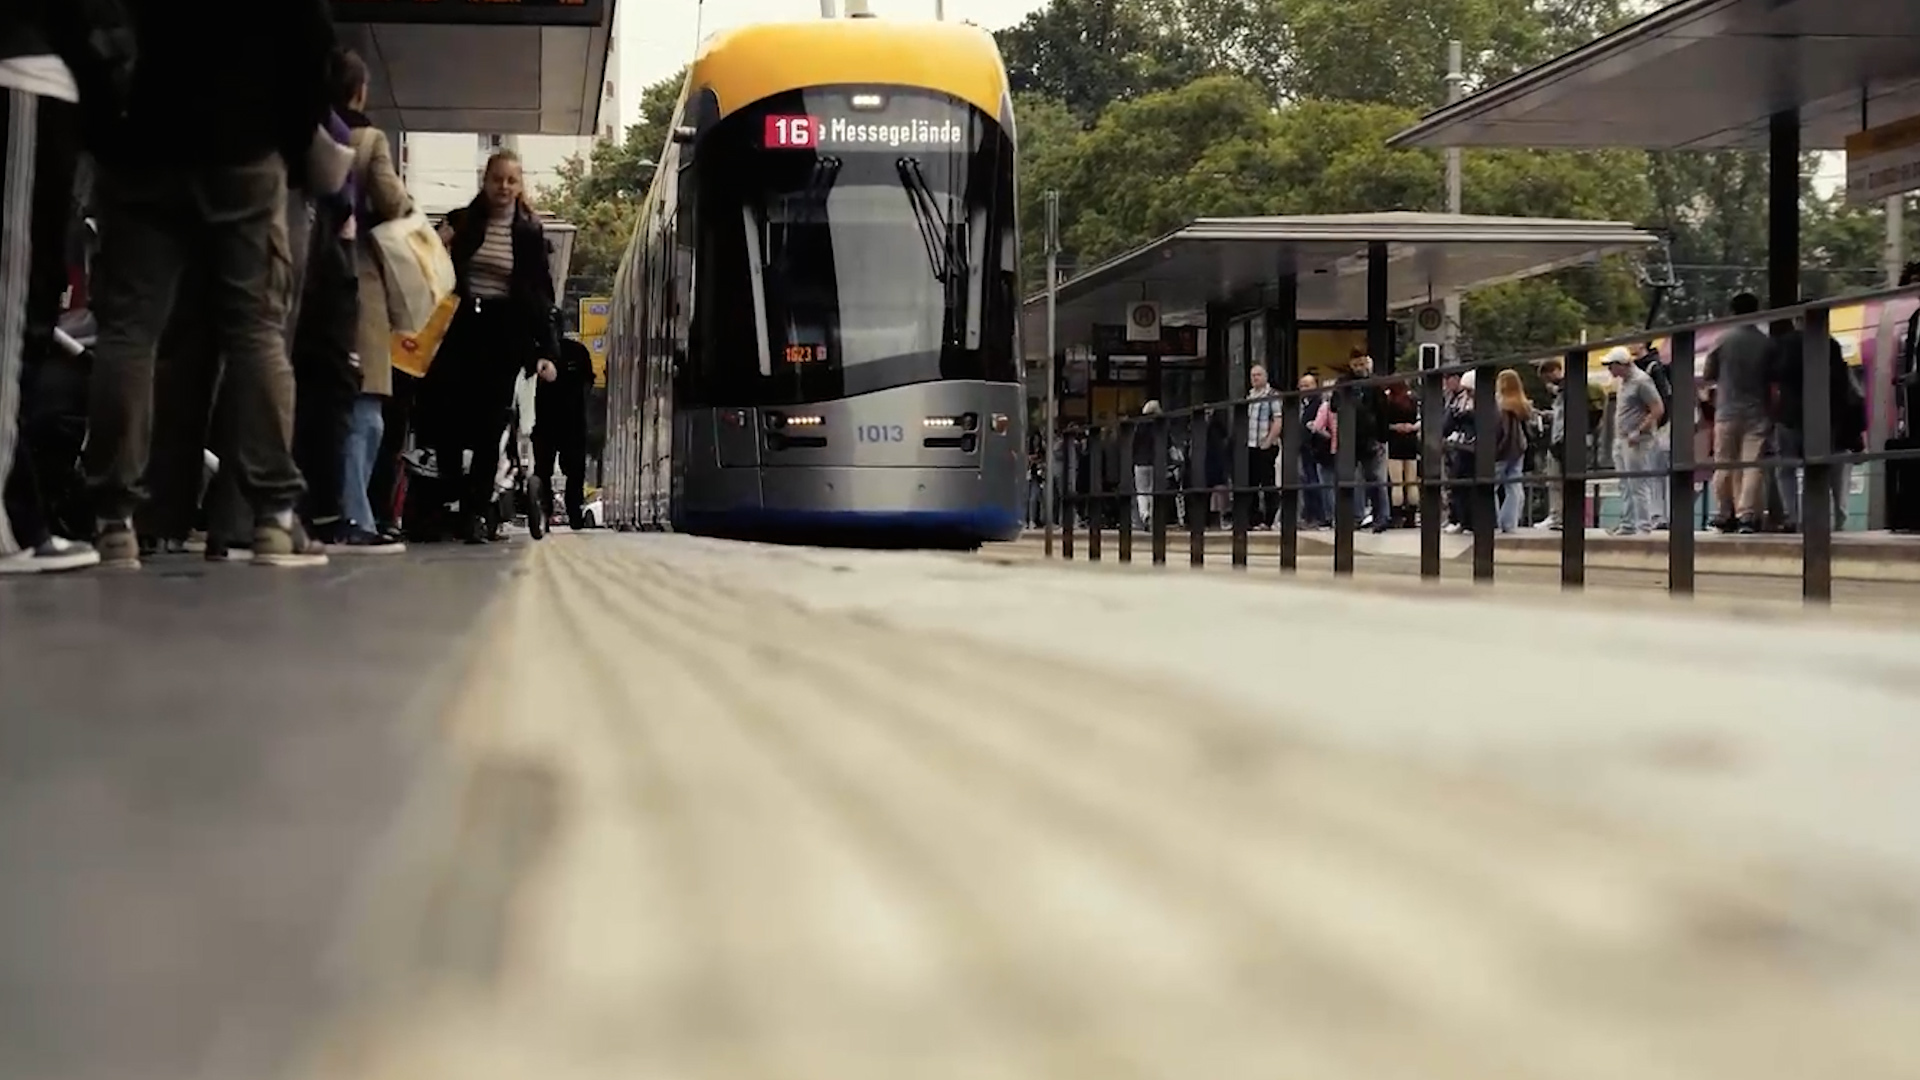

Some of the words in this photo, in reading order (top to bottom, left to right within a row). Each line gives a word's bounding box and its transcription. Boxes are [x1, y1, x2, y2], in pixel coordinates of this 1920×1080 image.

[775, 118, 809, 144] 16
[831, 118, 961, 147] Messegelände
[858, 425, 904, 442] 1013
